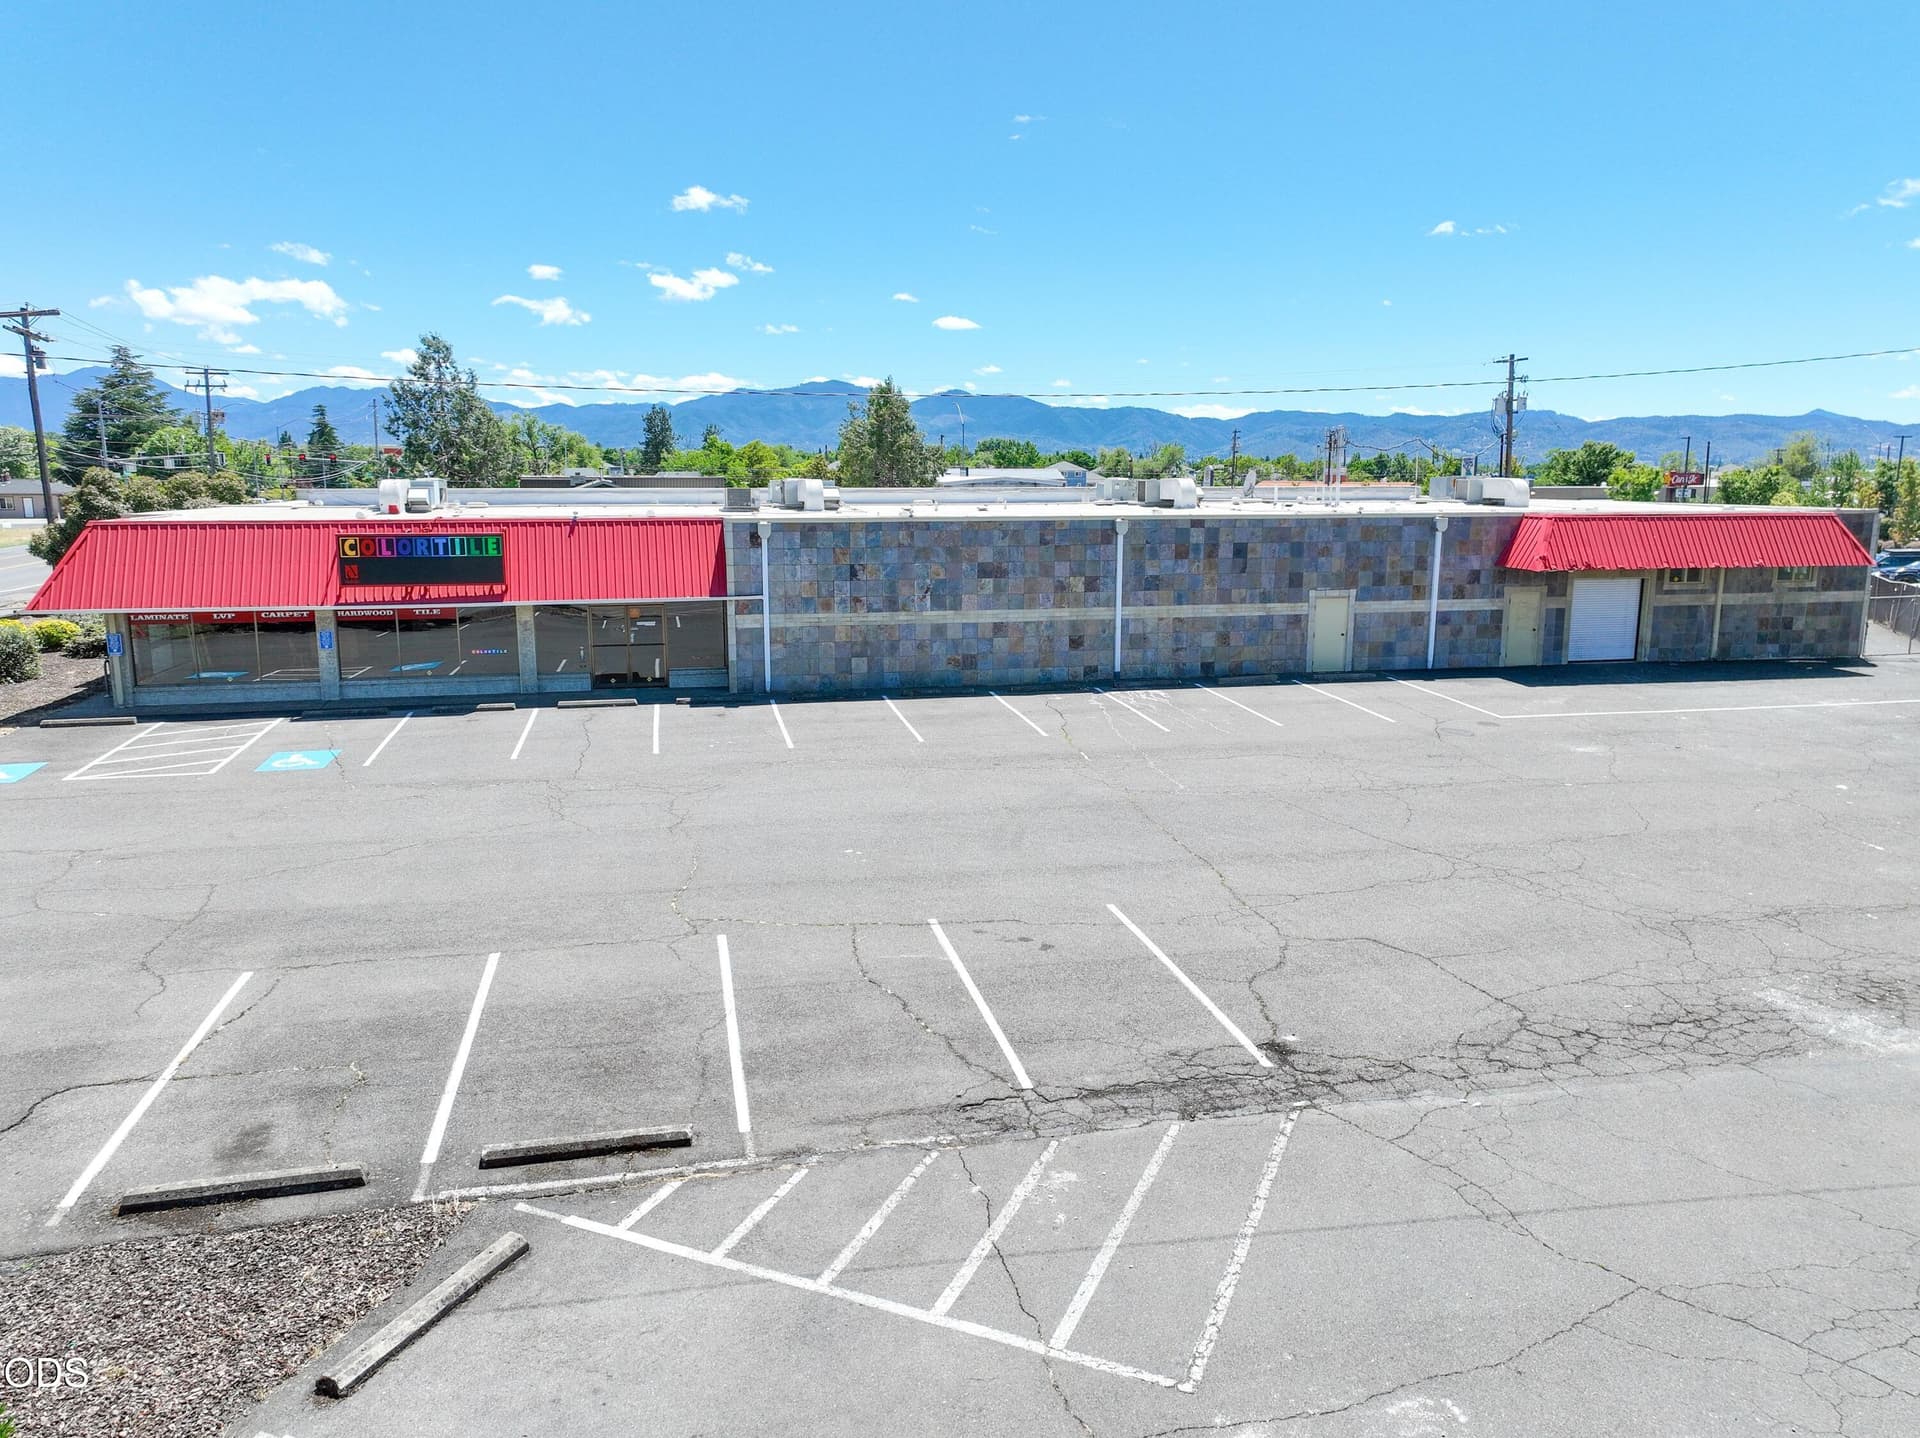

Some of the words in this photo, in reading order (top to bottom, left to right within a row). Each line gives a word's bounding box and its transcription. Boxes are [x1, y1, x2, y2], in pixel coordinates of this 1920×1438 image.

[342, 537, 499, 557] COLORTILE
[413, 608, 441, 616] TILE
[130, 613, 189, 621] LAMINATE
